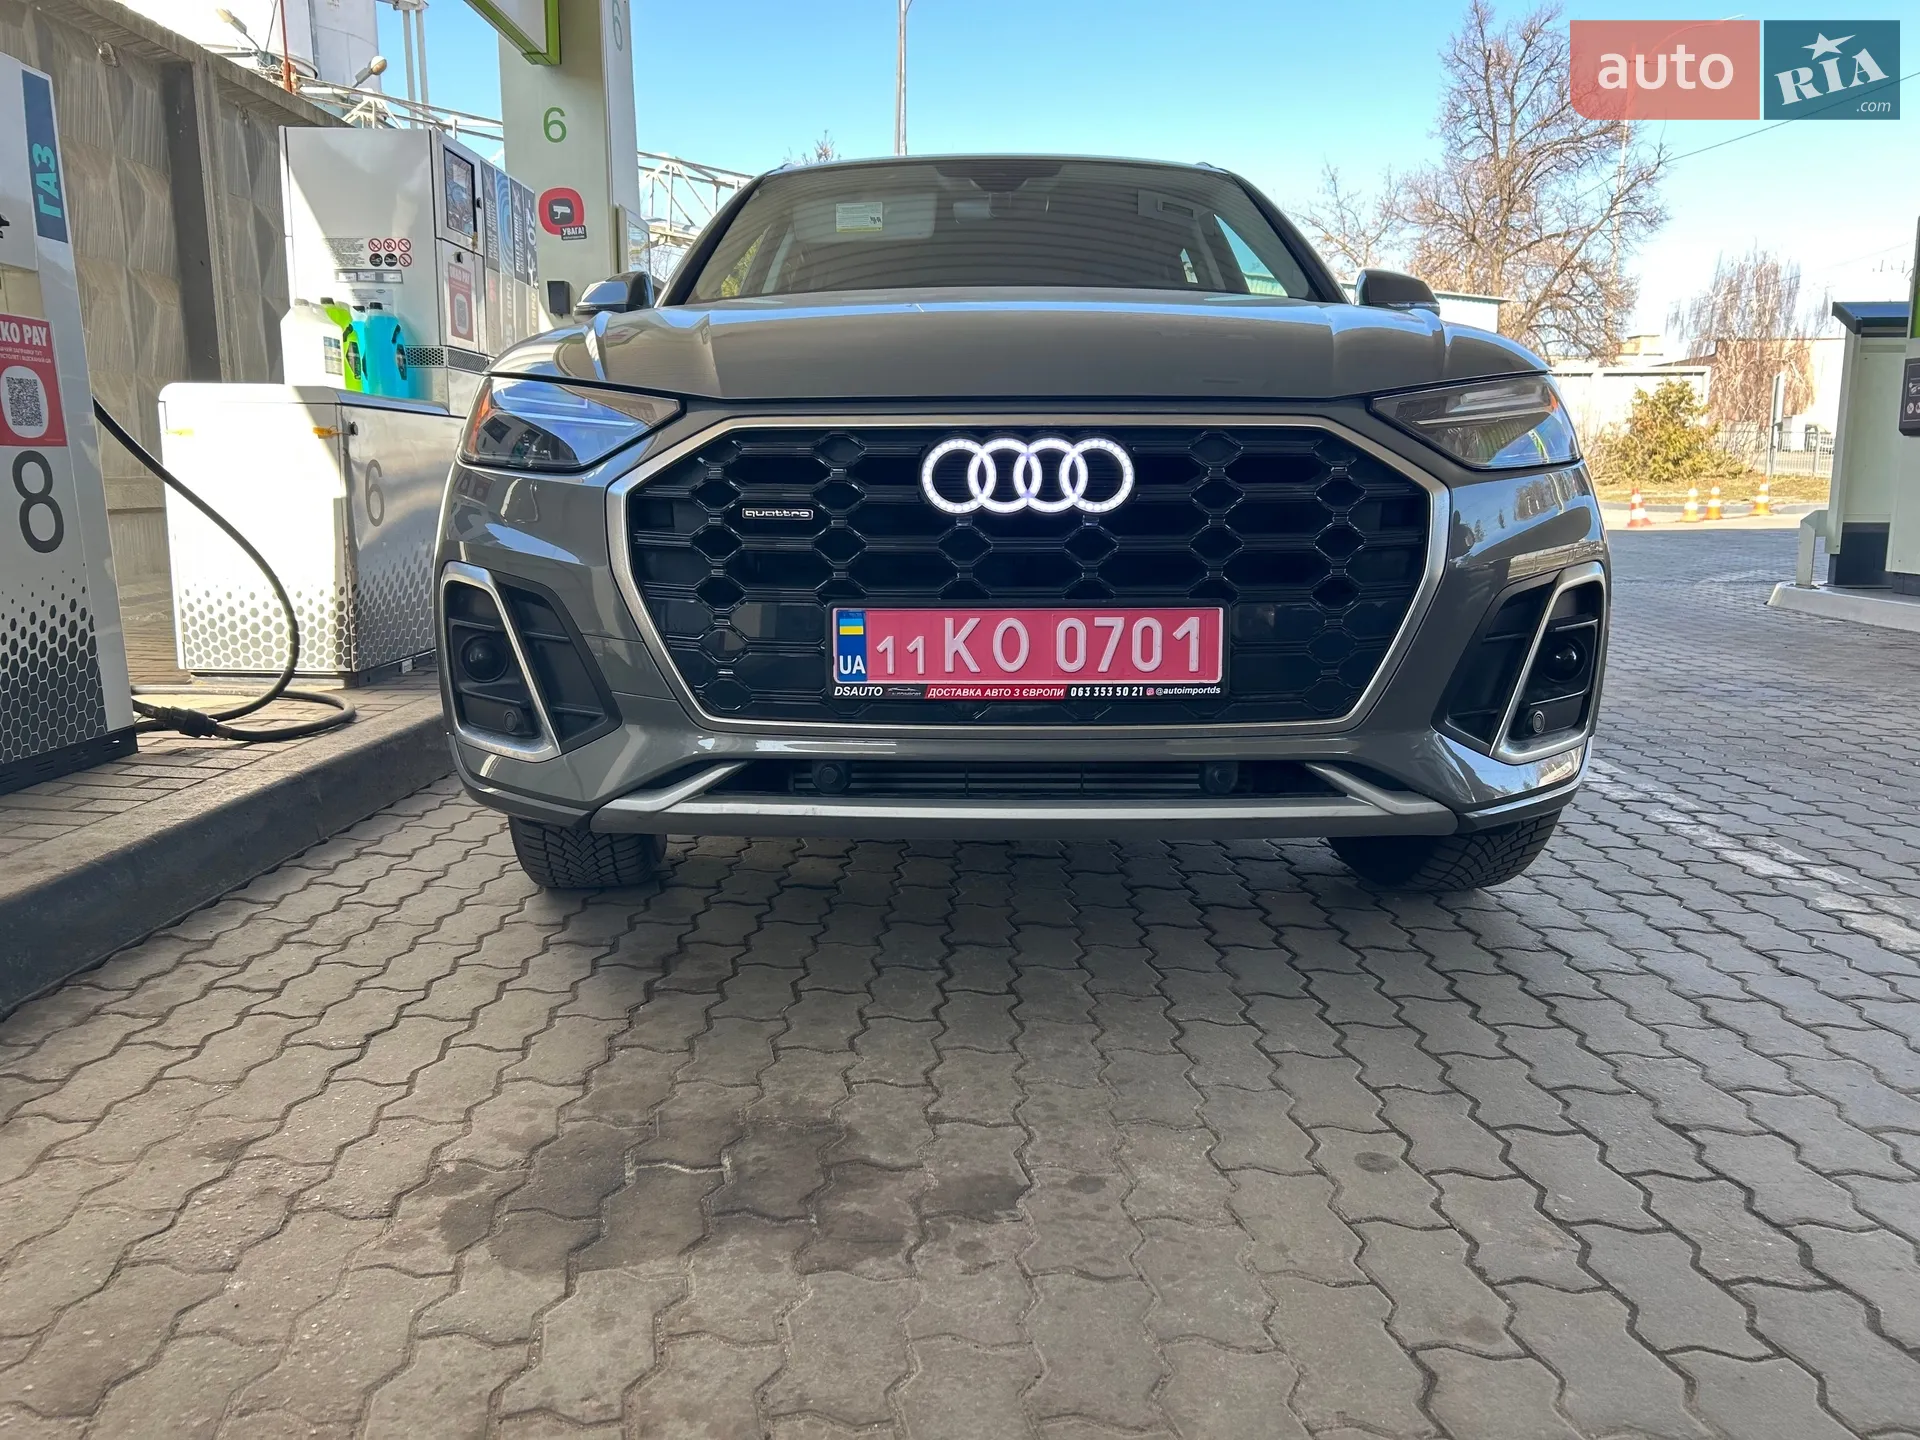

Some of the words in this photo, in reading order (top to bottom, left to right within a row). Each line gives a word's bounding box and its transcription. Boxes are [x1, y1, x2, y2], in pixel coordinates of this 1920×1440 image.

[543, 106, 567, 143] 6
[32, 143, 62, 218] ГАЗ
[562, 226, 585, 236] УВАГА!
[0, 321, 20, 344] KO
[22, 323, 47, 347] PAY
[12, 450, 64, 553] 8
[365, 459, 385, 527] 6
[745, 510, 809, 518] quattro
[876, 635, 925, 675] 11
[944, 617, 1030, 673] KO
[1056, 616, 1200, 673] 0701
[839, 655, 866, 674] UA
[834, 686, 884, 697] DSAUTO
[928, 688, 982, 699] ДОСТАВКА
[984, 688, 1011, 697] АВТО
[1022, 688, 1064, 697] ЄВРОПИ
[1070, 687, 1090, 697] 063
[1093, 687, 1113, 697] 353
[1115, 687, 1128, 696] 50
[1131, 686, 1143, 696] 21
[1155, 686, 1221, 696] @autoimportds
